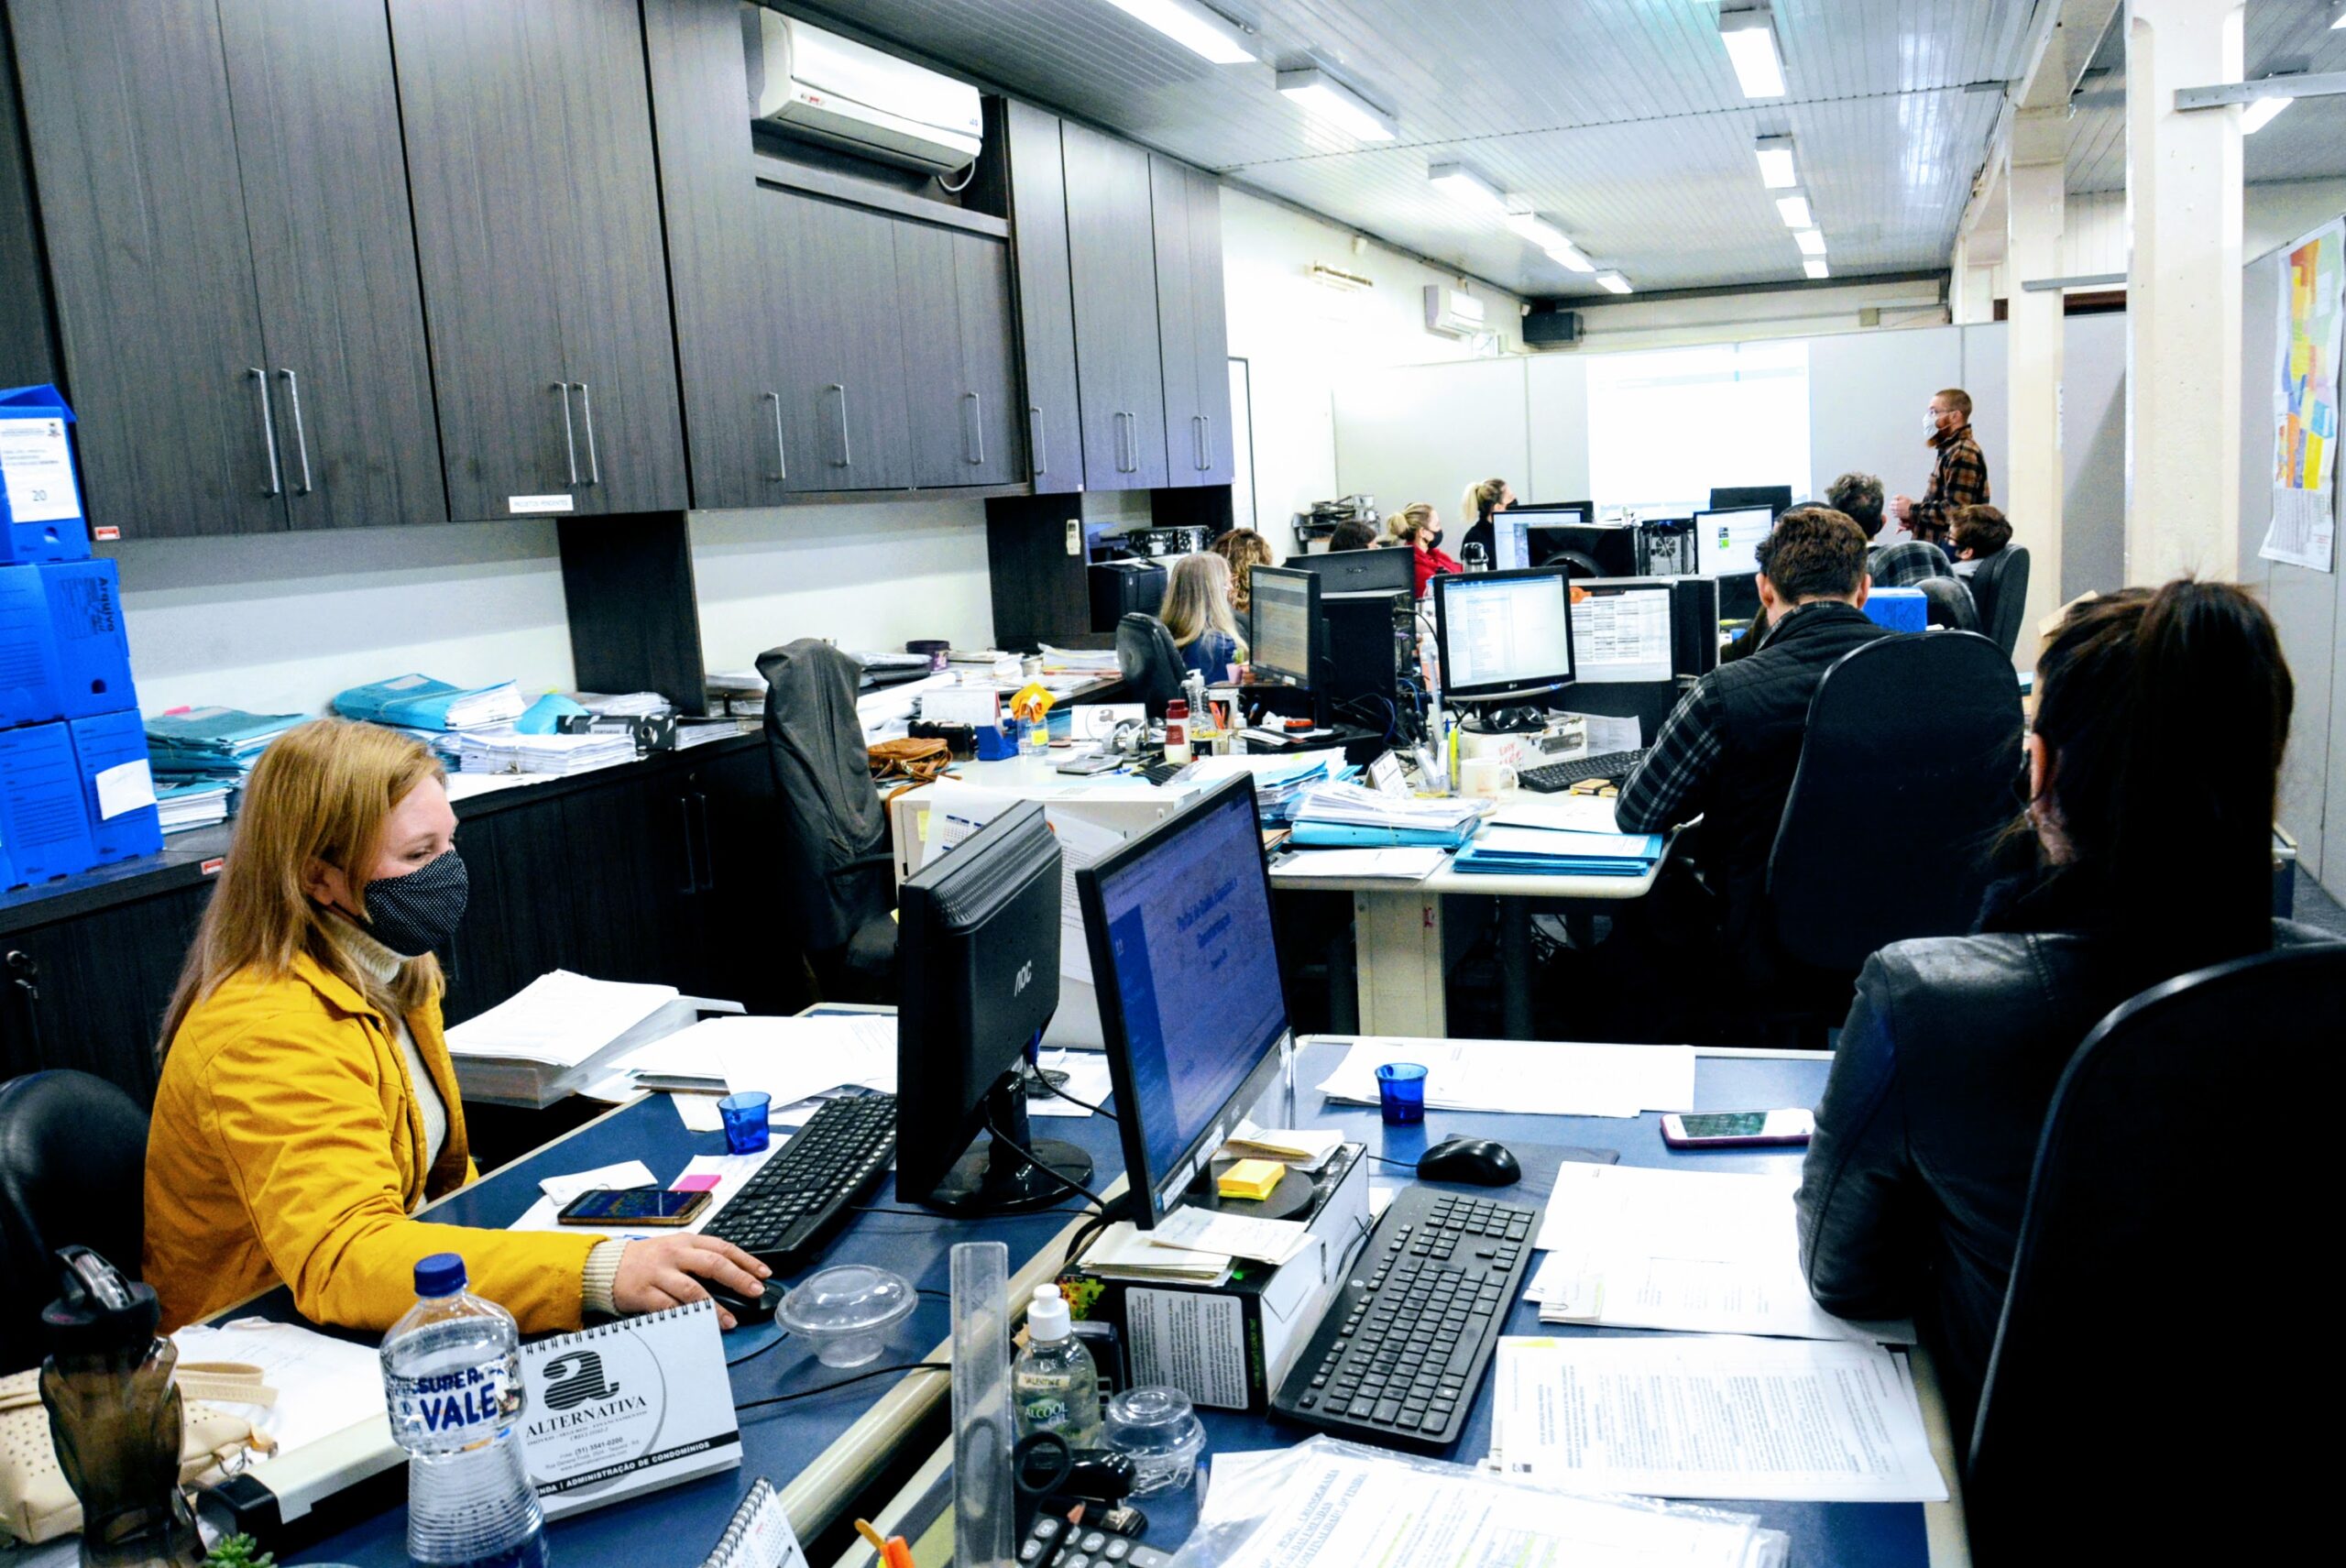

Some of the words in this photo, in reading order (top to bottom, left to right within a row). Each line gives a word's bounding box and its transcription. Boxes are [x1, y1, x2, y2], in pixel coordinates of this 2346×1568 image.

[32, 489, 47, 502] 20
[100, 576, 115, 632] Arquivo
[417, 1366, 478, 1395] SUPER
[419, 1381, 499, 1432] VALE
[526, 1396, 646, 1438] ALTERNATIVA
[1025, 1401, 1069, 1419] ALCOOL
[539, 1484, 558, 1496] NDA
[566, 1461, 636, 1488] ADMINISTRAÇÃO
[638, 1457, 650, 1468] DE
[652, 1440, 711, 1464] CONDOMÍNIOS
